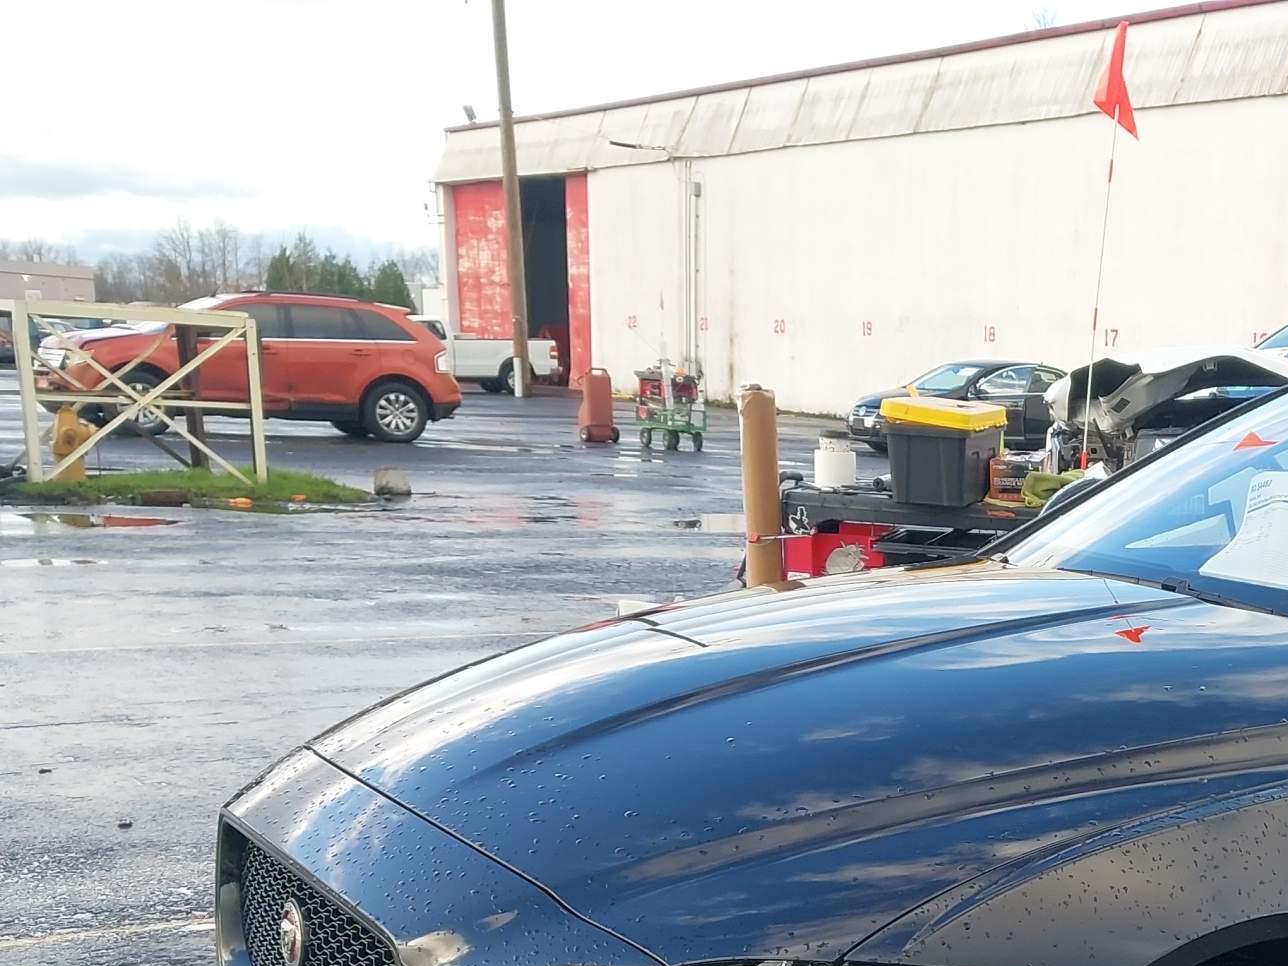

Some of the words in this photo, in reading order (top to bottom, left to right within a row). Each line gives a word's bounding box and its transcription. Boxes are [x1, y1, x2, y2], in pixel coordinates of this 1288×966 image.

[774, 319, 785, 334] 20
[862, 320, 873, 337] 19
[983, 325, 996, 342] 18
[1104, 328, 1119, 347] 17
